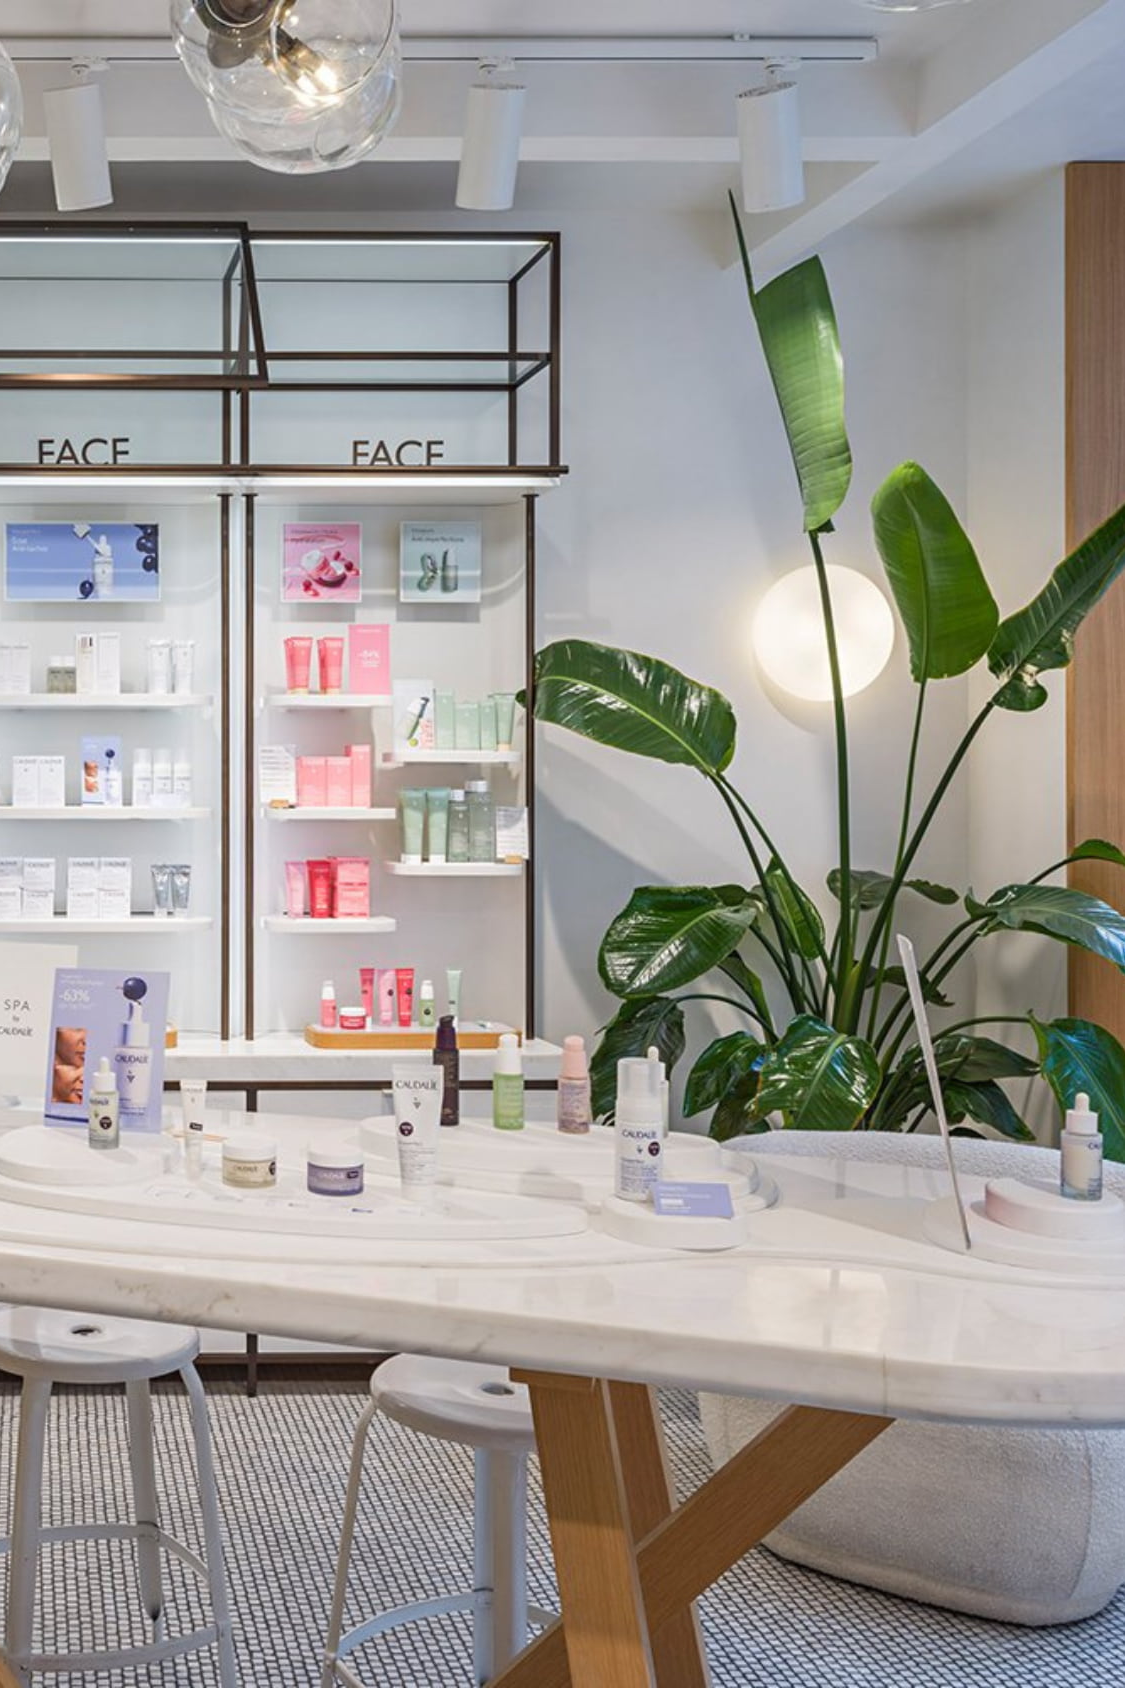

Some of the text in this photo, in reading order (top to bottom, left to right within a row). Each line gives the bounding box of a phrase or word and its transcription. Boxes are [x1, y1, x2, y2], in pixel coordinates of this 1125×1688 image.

[4, 999, 31, 1011] SPA
[395, 1079, 438, 1091] CAUDALIE
[621, 1129, 657, 1139] CAUDALIE
